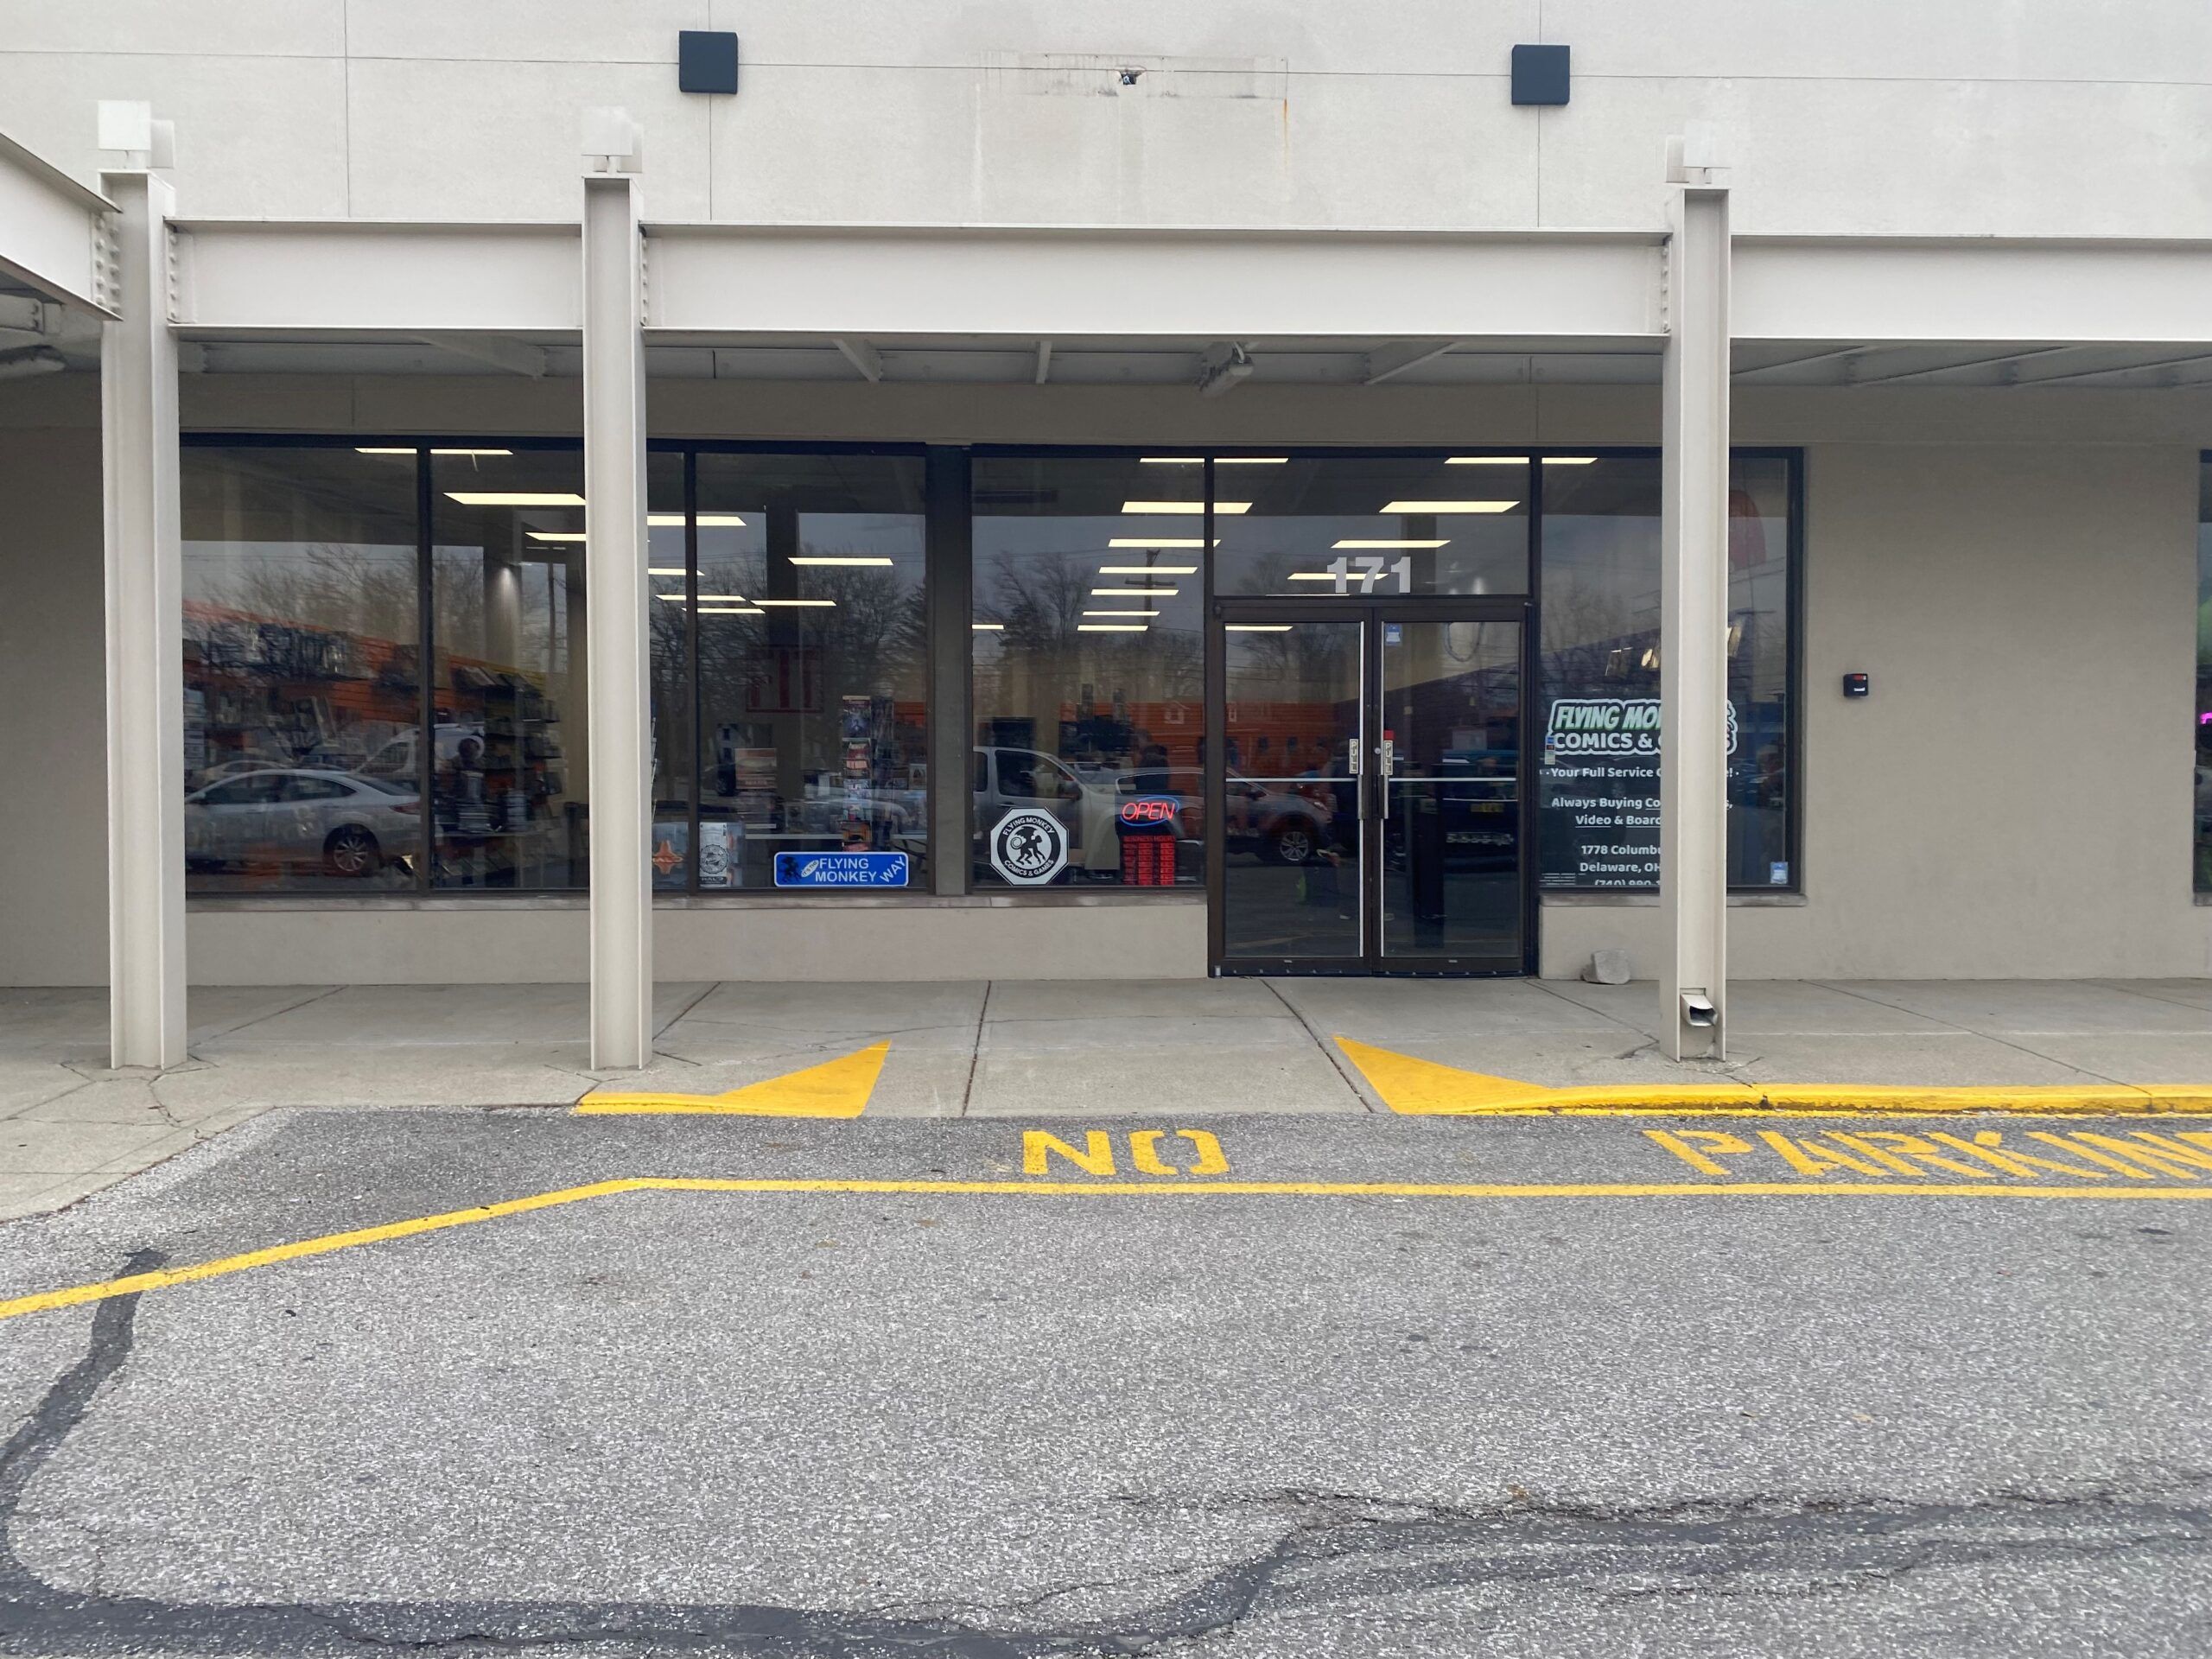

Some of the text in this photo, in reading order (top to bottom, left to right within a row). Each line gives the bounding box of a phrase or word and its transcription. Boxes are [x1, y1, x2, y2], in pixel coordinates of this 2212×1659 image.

[1326, 556, 1411, 594] 171
[1554, 706, 1620, 730] FLYING
[1555, 733, 1633, 749] COMICS
[1637, 733, 1653, 749] &
[1551, 768, 1580, 778] Your
[1582, 767, 1605, 778] Full
[1607, 767, 1654, 778] Service
[1122, 802, 1176, 820] OPEN
[1551, 798, 1597, 809] Always
[1599, 797, 1643, 810] Buying
[1002, 817, 1055, 836] FLYING MONKEY
[1575, 814, 1611, 825] Video
[1614, 816, 1624, 825] &
[1580, 845, 1608, 855] 1778
[815, 855, 906, 883] MONKEY WAY
[819, 857, 869, 869] FLYING
[1004, 860, 1027, 876] COMICS
[1033, 859, 1054, 874] GAMES
[1580, 861, 1642, 873] Delaware,
[1022, 1129, 2212, 1179] NO PARKIN
